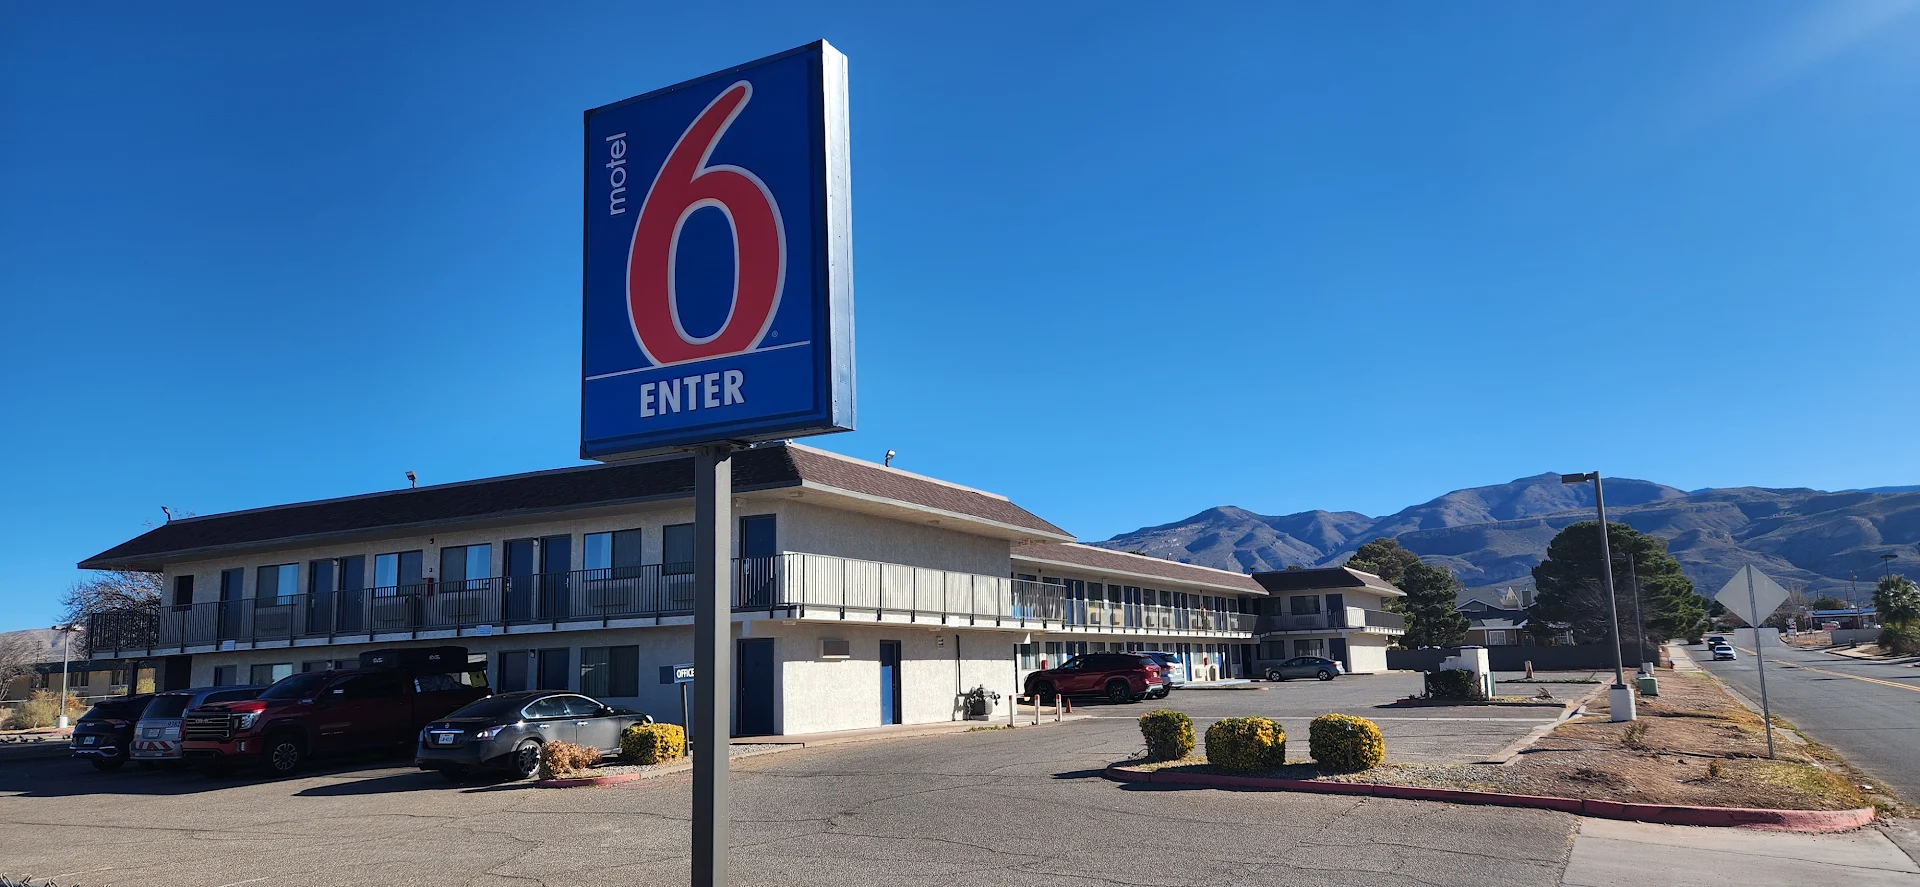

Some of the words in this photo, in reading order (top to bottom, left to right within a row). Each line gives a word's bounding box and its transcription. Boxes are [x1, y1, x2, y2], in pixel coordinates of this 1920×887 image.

[606, 132, 627, 216] motel
[626, 79, 787, 367] 6
[640, 369, 745, 418] ENTER
[676, 668, 694, 678] OFFICE
